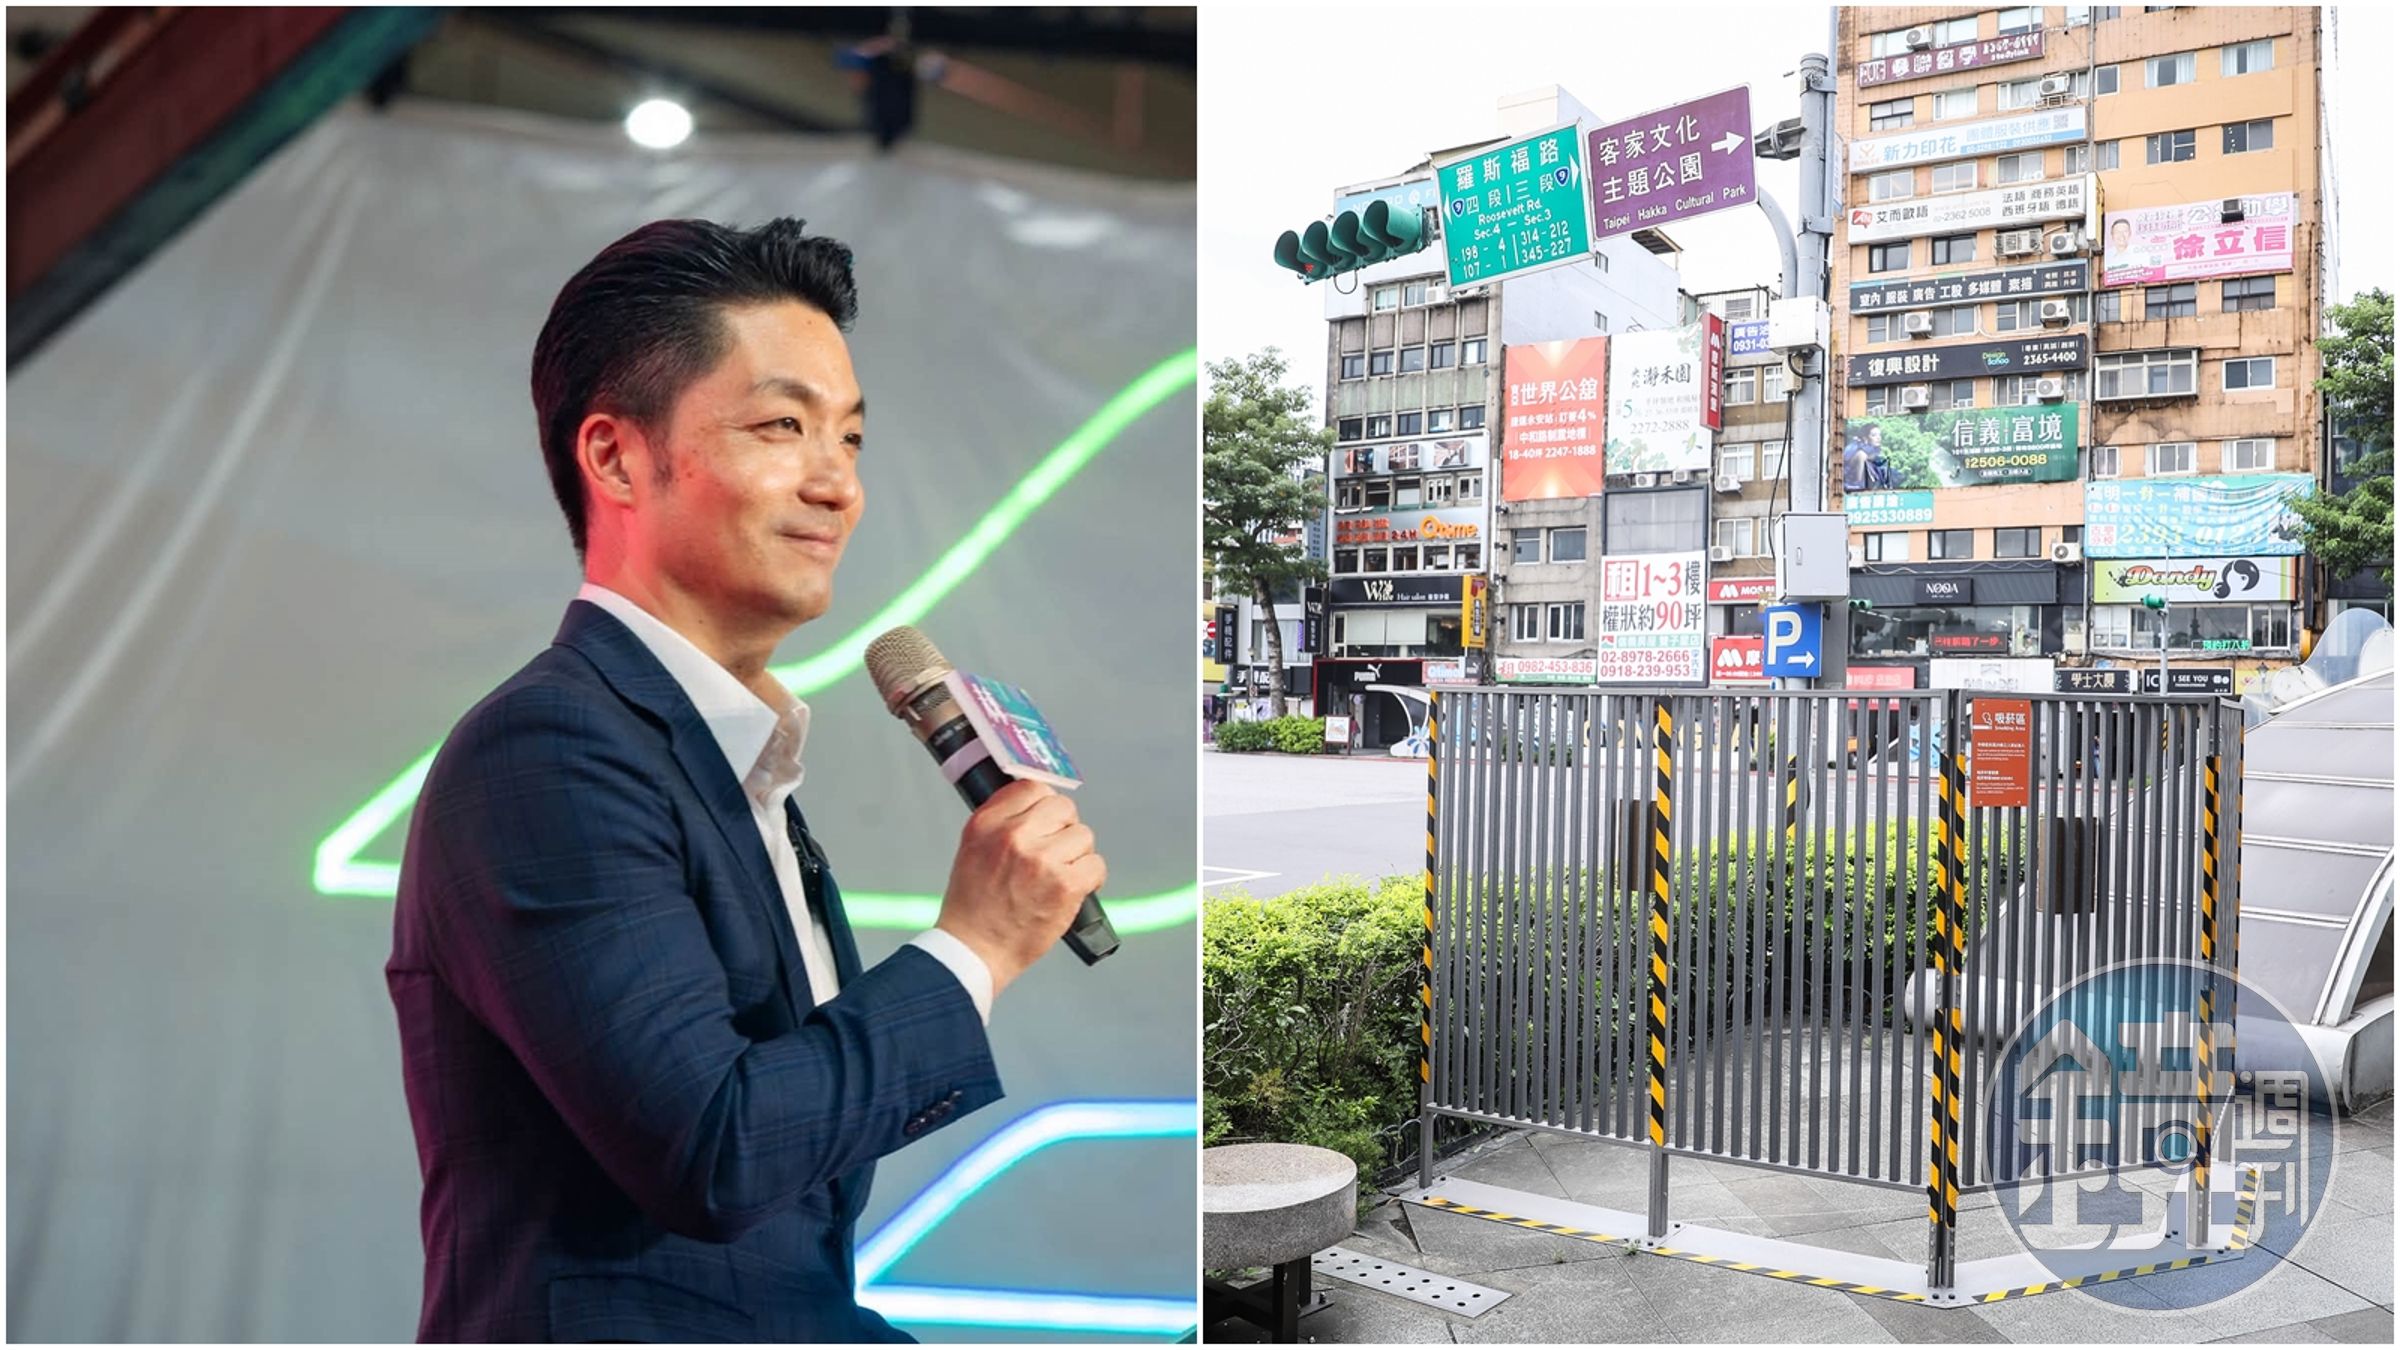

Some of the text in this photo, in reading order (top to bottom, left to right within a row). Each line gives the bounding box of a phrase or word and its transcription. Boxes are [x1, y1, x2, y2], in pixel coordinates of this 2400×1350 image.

[1600, 114, 1700, 167] 客家文化
[1883, 135, 1957, 162] 新力印花
[1456, 138, 1559, 193] 羅斯福路
[1603, 152, 1703, 204] 主題公園
[1466, 188, 1502, 216] 四段
[1516, 174, 1555, 200] 三段
[2002, 184, 2080, 203] 法語 商務英語
[1478, 197, 1543, 226] Roosevelt Rd.
[1603, 183, 1746, 231] Taipei Hakka Cultural Park
[1968, 206, 1992, 218] 5008
[2001, 201, 2050, 217] 西班牙語
[2055, 197, 2080, 211] 德語
[1474, 208, 1552, 241] Sec.4 Sec.3
[1520, 220, 1569, 246] 314-212
[1521, 236, 1572, 264] 345-227
[2173, 225, 2287, 261] 徐立信
[1859, 292, 1881, 308] 室內
[1885, 290, 1909, 306] 服裝
[1912, 287, 1936, 303] 廣告
[1967, 278, 2003, 297] 多媒體
[2008, 276, 2033, 292] 素描
[1867, 353, 1940, 376] 復興設計
[2023, 351, 2077, 365] 2365-4400
[1630, 420, 1690, 434] 2272-2888
[1545, 445, 1597, 458] 2247-1888
[1970, 454, 2047, 468] 2506-0088
[1642, 560, 1700, 597] 1~3樓
[2125, 565, 2216, 590] Dandy
[1741, 586, 1763, 595] MOS
[1603, 601, 1701, 632] 權狀約90坪
[1767, 611, 1802, 665] P
[1518, 661, 1593, 673] 0982-453-836
[1601, 650, 1690, 662] 02-8978-2666
[1600, 664, 1690, 677] 0918-239-953
[2071, 673, 2115, 688] 學士大廈
[1995, 713, 2025, 725] 吸菸區
